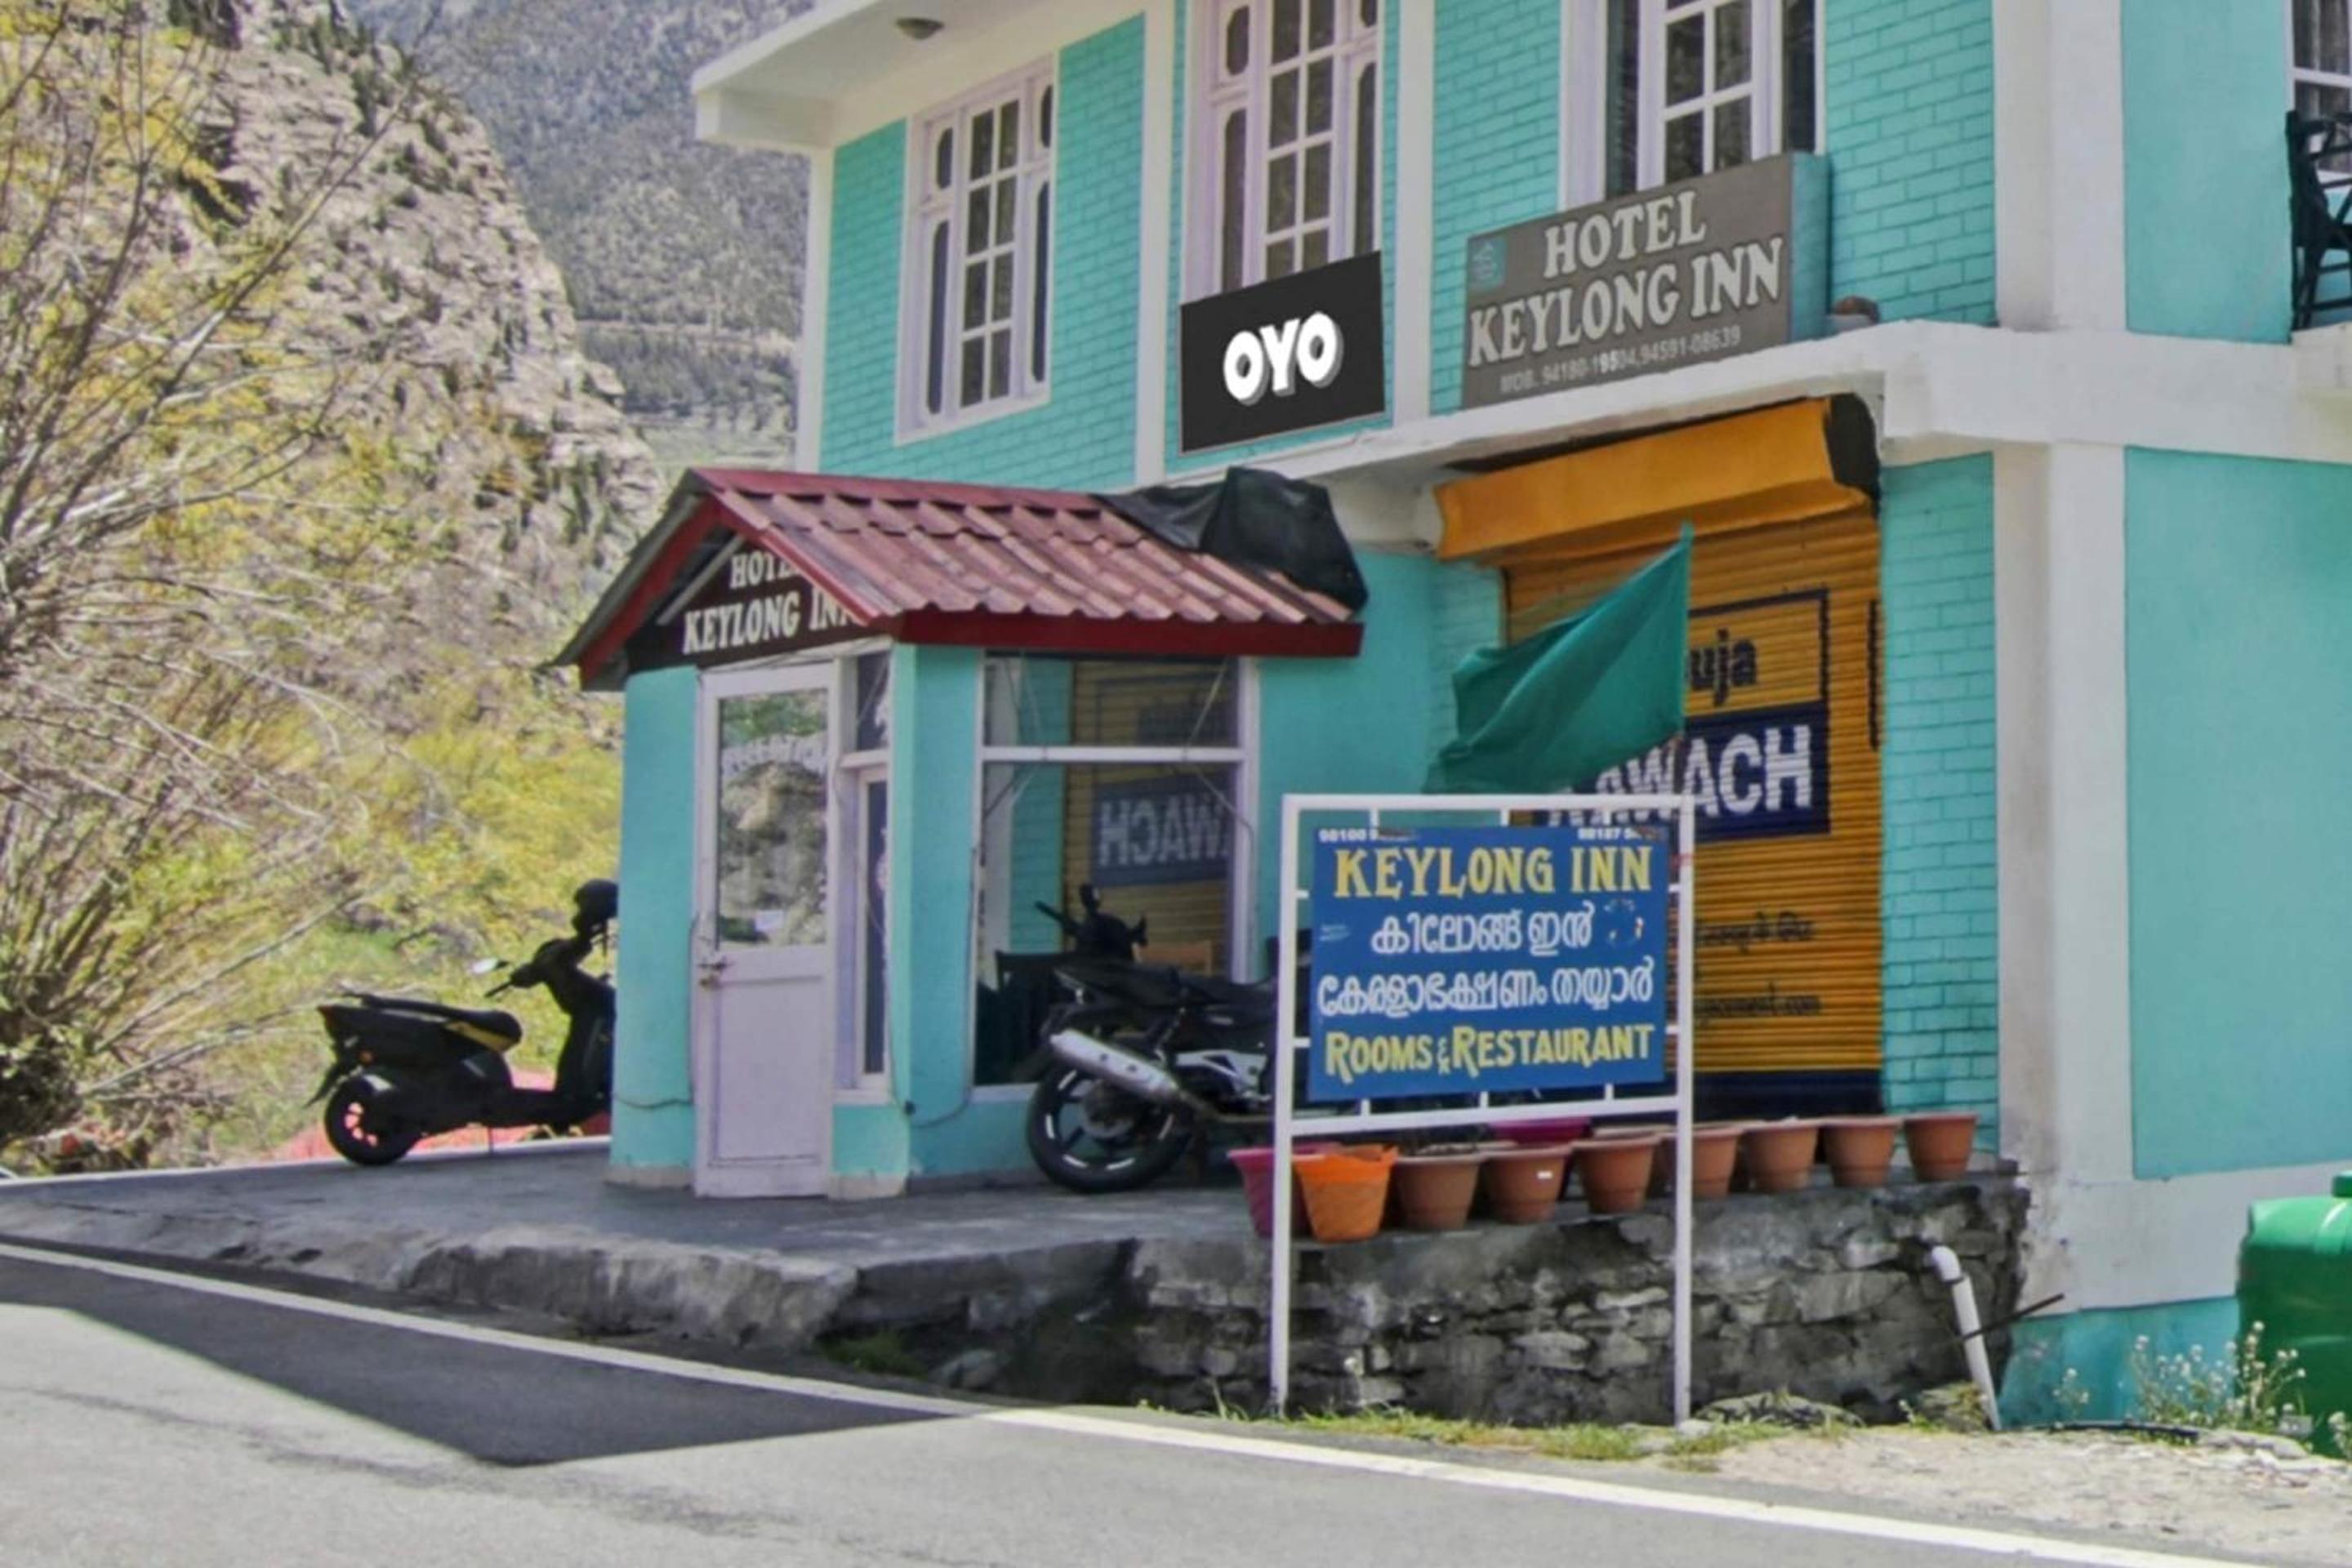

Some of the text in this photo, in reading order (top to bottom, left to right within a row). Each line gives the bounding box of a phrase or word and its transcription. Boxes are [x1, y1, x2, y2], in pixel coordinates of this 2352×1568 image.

[1544, 190, 1706, 278] HOTEL
[1468, 238, 1784, 366] KEYLONG INN
[1223, 310, 1344, 407] OYO
[682, 590, 801, 654] KEYLONG
[1333, 845, 1653, 900] KEYLONG INN
